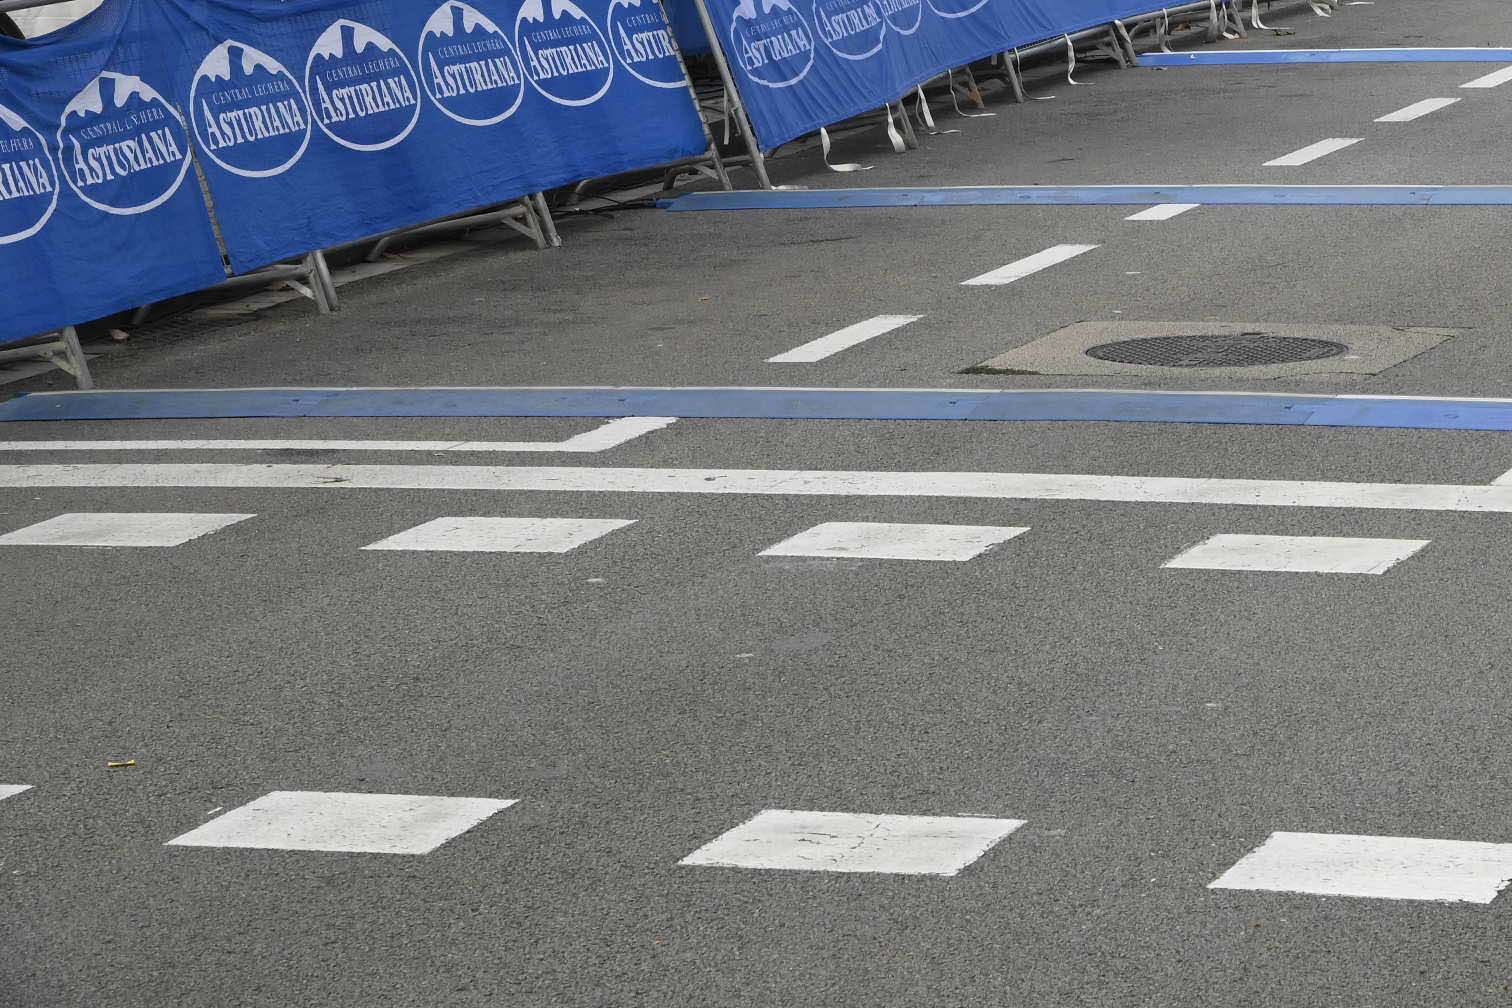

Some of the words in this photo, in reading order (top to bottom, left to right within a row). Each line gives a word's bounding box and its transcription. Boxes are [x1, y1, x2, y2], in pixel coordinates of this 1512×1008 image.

[326, 65, 362, 81] CENTRAL
[362, 57, 401, 72] LECHERA
[428, 51, 521, 100] ASTURIANA
[523, 35, 609, 81] ASTURIANA
[212, 88, 250, 105] CENTRAL
[253, 79, 291, 97] LECHERA
[316, 74, 417, 126] ASTURIANA
[201, 96, 306, 152] ASTURIANA
